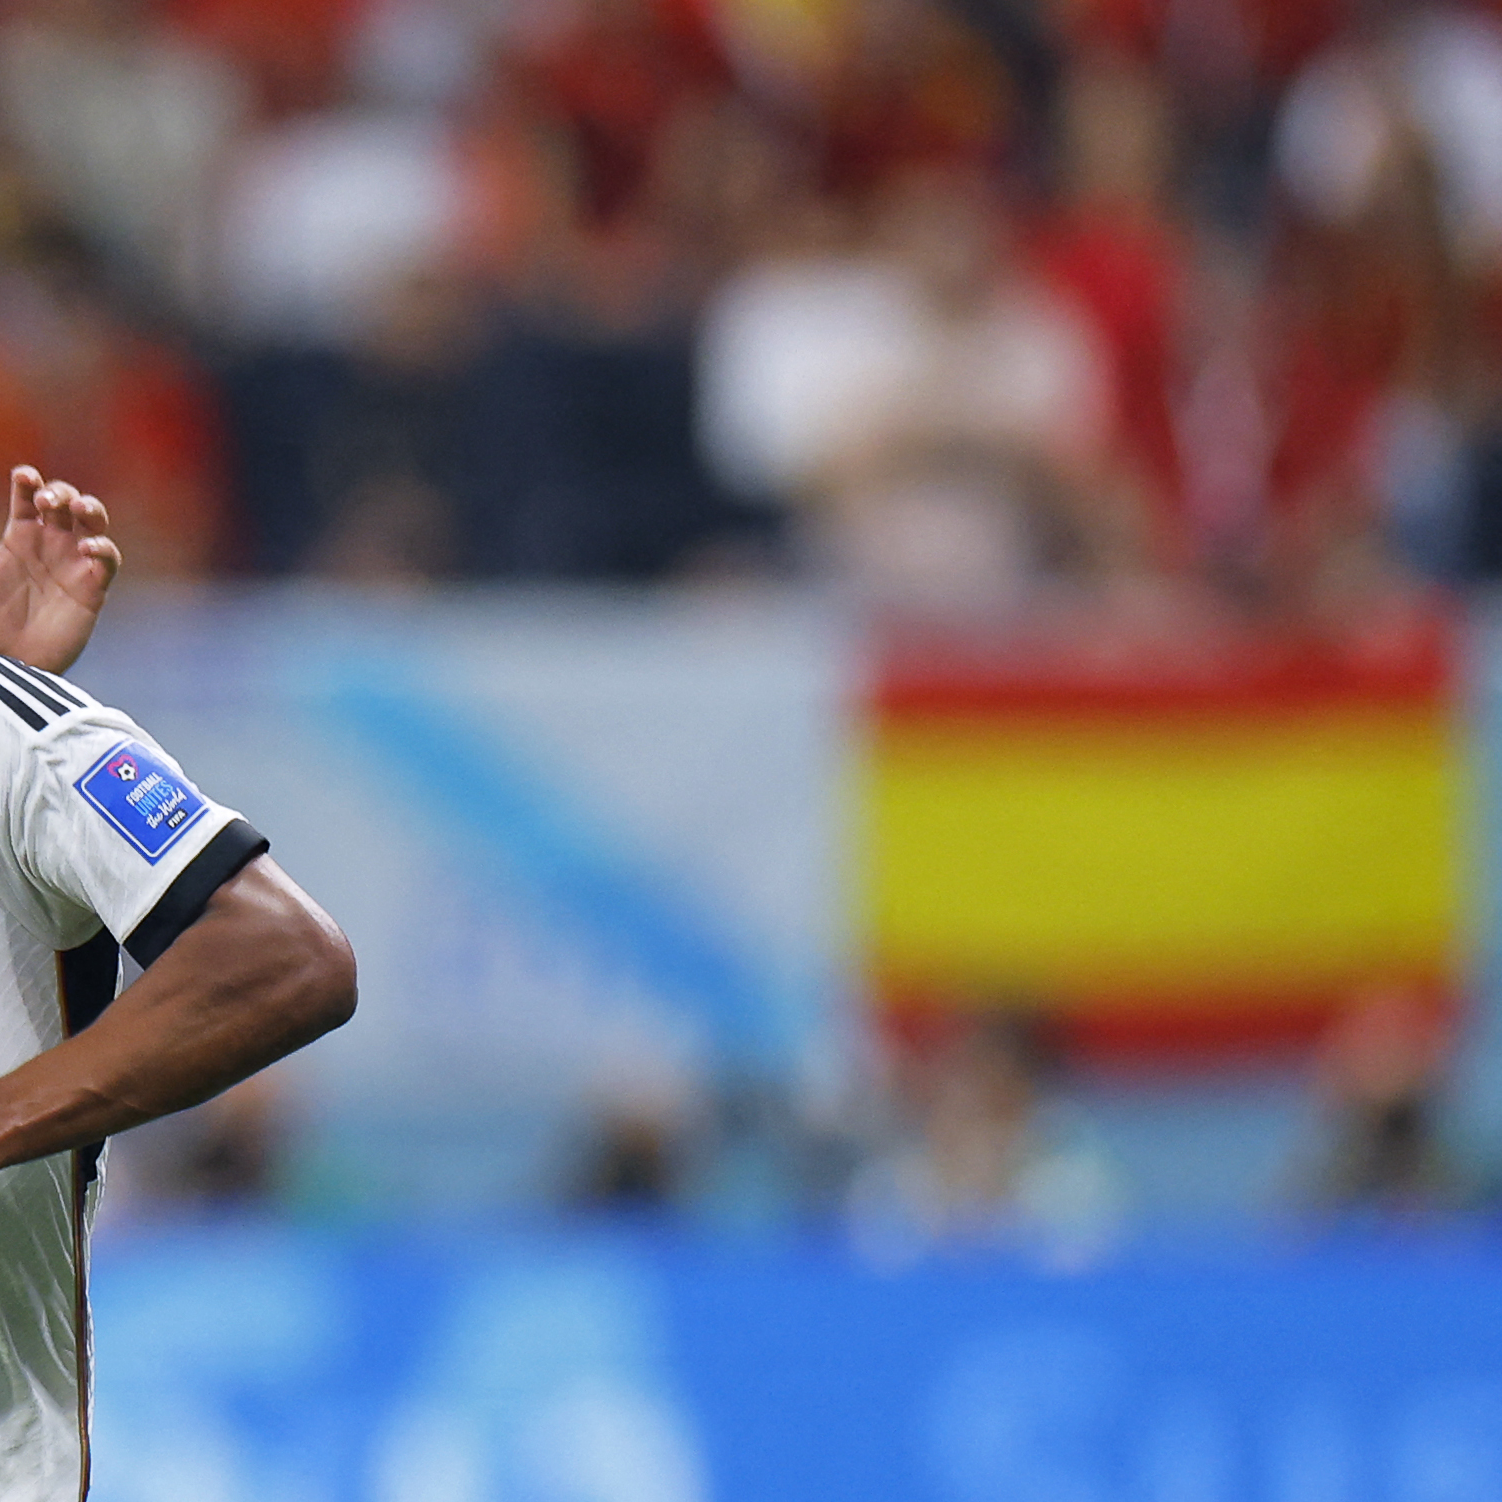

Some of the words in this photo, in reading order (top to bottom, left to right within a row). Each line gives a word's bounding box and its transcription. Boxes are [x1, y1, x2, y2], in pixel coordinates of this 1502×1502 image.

[125, 771, 163, 806] FOOTBALL
[136, 780, 174, 817] UNITES
[146, 812, 165, 829] the
[158, 787, 188, 817] World
[167, 808, 187, 828] FIFA
